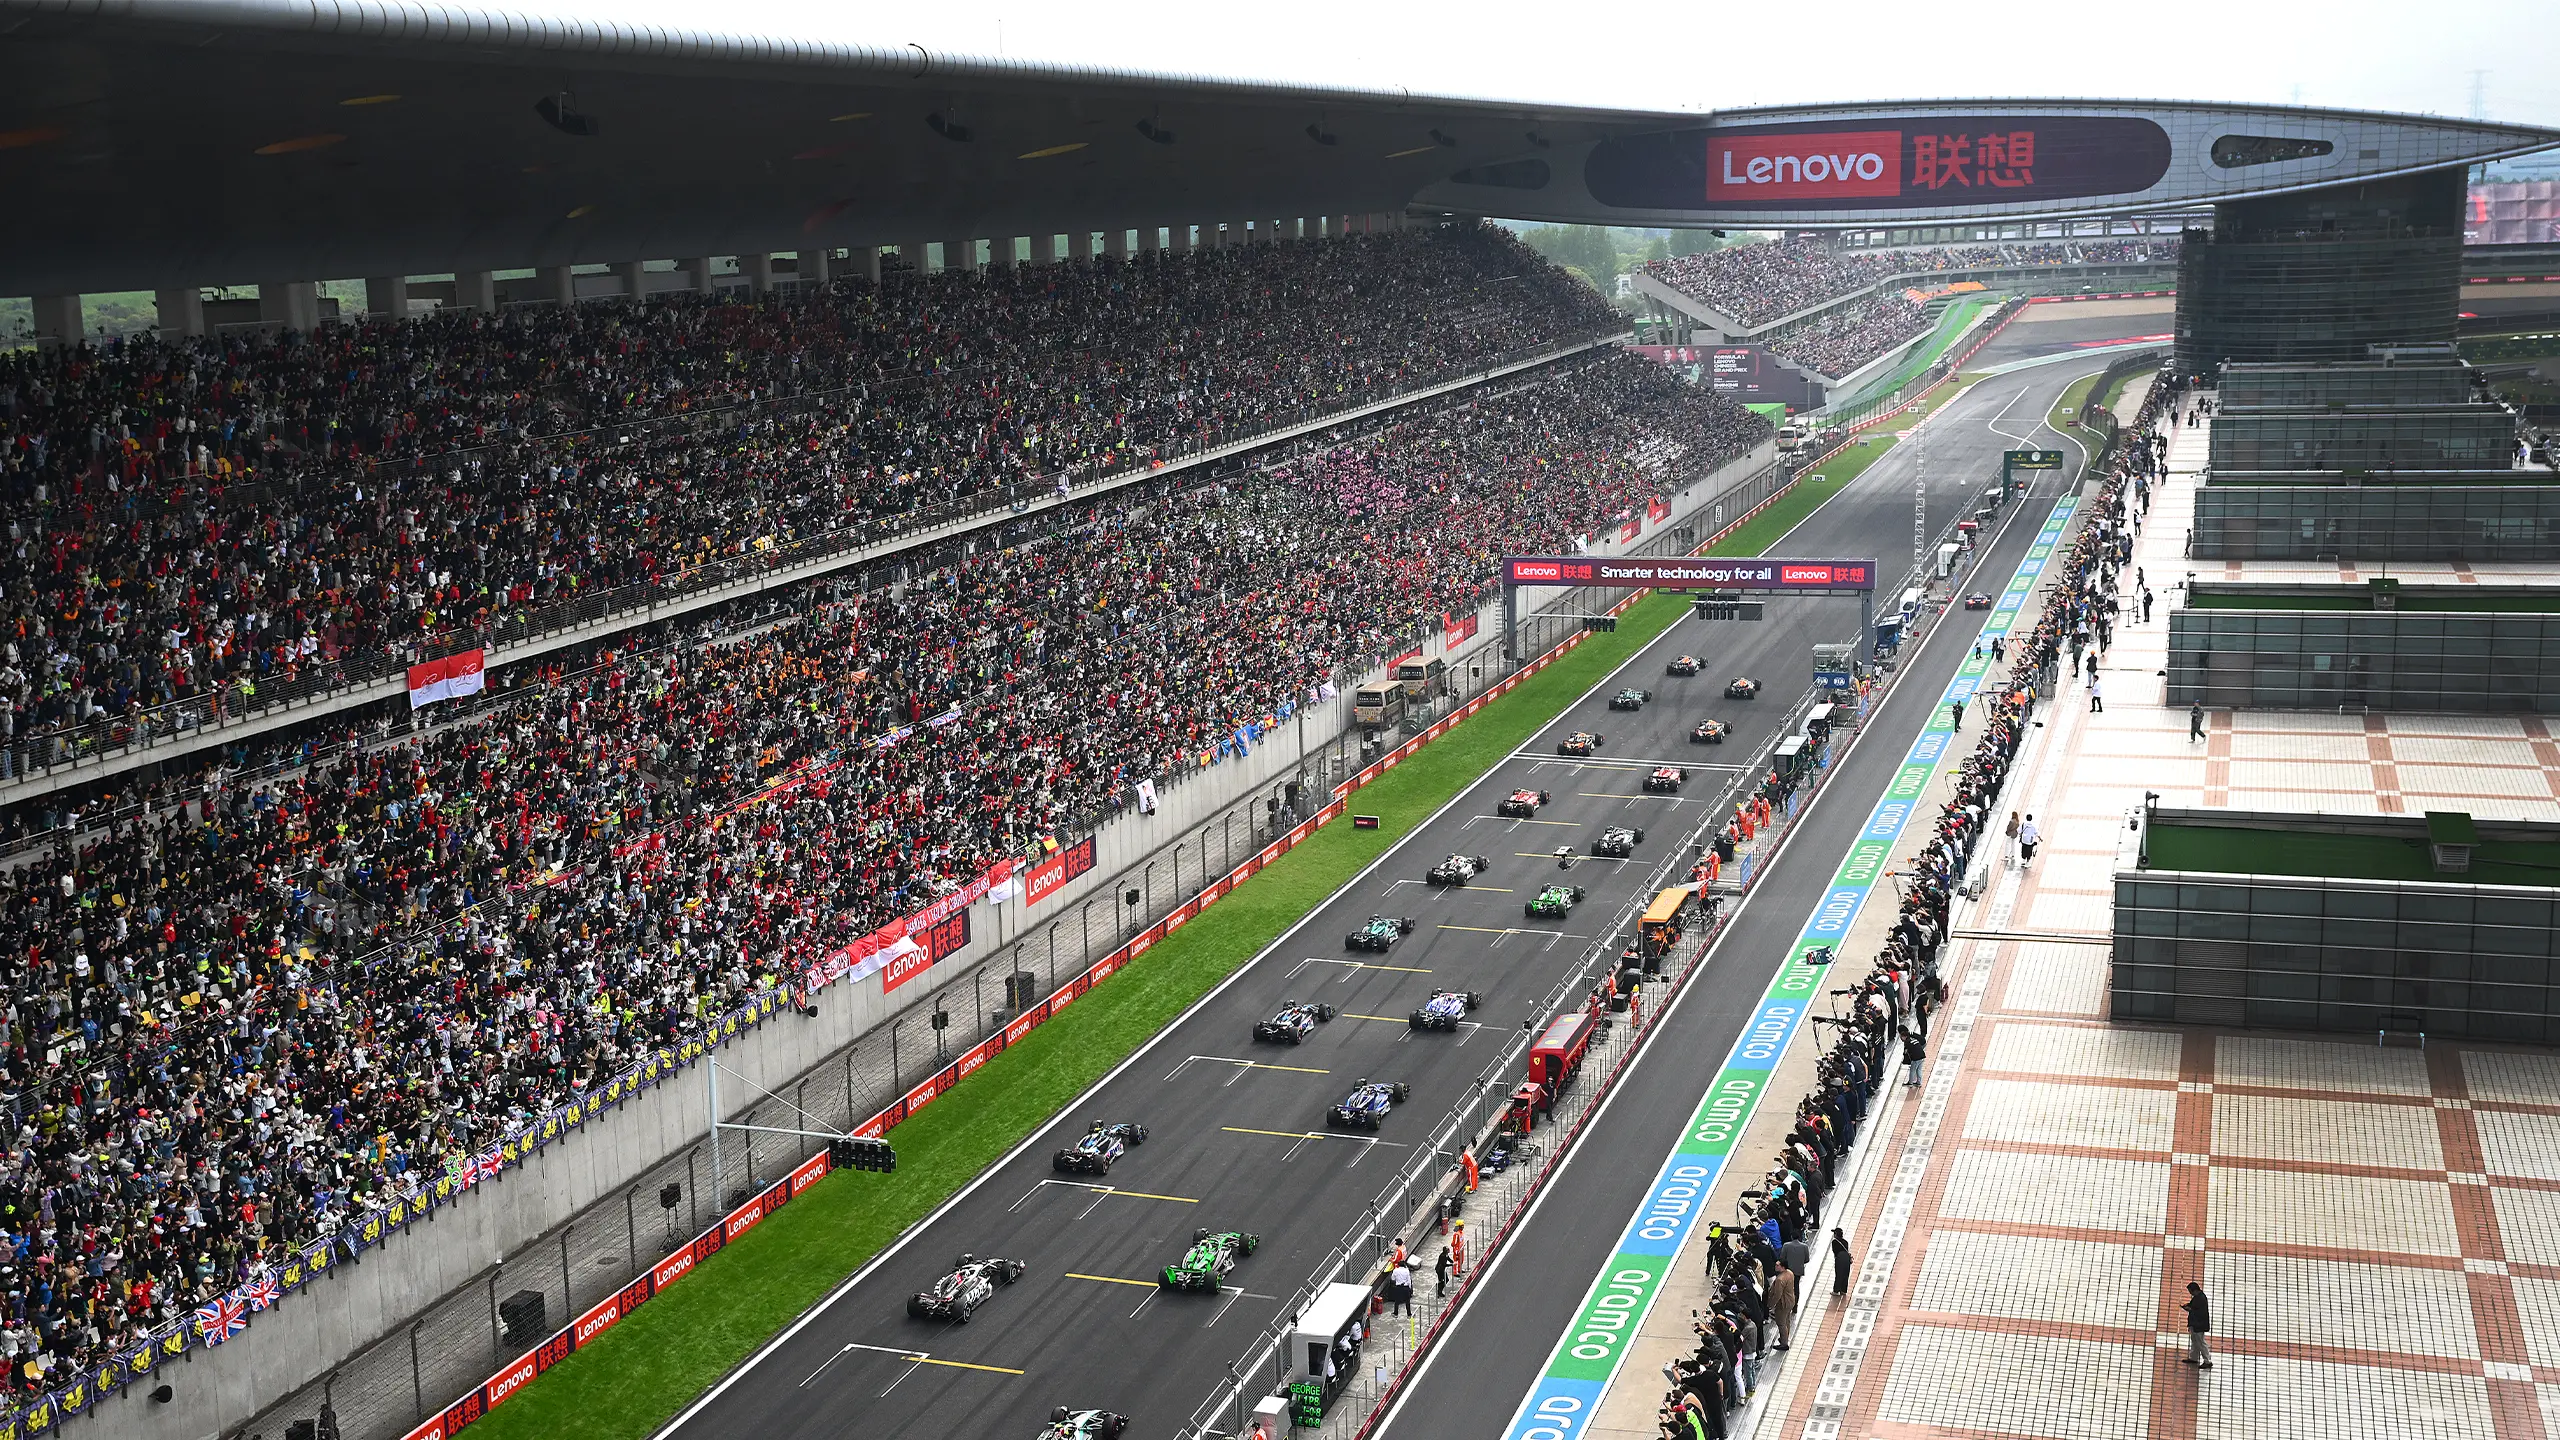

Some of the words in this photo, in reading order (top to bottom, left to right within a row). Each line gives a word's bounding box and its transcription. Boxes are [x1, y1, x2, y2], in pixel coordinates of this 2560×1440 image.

[1723, 150, 1884, 185] Lenovo
[1912, 131, 2034, 190] 联想
[1517, 566, 1557, 576] Lenovo
[1563, 565, 1592, 579] 联想
[1601, 566, 1653, 579] Smarter
[1657, 566, 1732, 582] technology
[1734, 567, 1754, 580] for
[1756, 567, 1772, 580] all
[1785, 569, 1827, 580] Lenovo
[1834, 567, 1865, 582] 联想
[1893, 767, 1927, 795] aramco
[1870, 804, 1908, 835] aramco
[1066, 841, 1091, 879] 联想
[1262, 847, 1277, 864] Lenovo
[1845, 845, 1885, 880] aramco
[1029, 865, 1062, 897] Lenovo
[1233, 868, 1248, 885] Lenovo
[1201, 889, 1217, 908] Lenovo
[1814, 891, 1859, 931] aramco
[934, 914, 963, 957] 联想
[1167, 912, 1184, 931] Lenovo
[1131, 936, 1149, 955] Lenovo
[888, 944, 928, 983] Lenovo
[1092, 963, 1111, 983] Lenovo
[1051, 990, 1071, 1011] Lenovo
[1007, 1019, 1029, 1042] Lenovo
[1741, 1007, 1795, 1059] aramco
[986, 1033, 1002, 1059] 联想
[960, 1051, 983, 1075] Lenovo
[937, 1067, 954, 1095] 联想
[588, 1095, 600, 1112] 44
[909, 1085, 934, 1110] Lenovo
[1694, 1080, 1756, 1142] aramco
[544, 1119, 556, 1138] 44
[567, 1106, 580, 1125] 44
[883, 1103, 902, 1133] 联想
[521, 1131, 533, 1152] 44
[859, 1122, 880, 1146] novo
[794, 1163, 823, 1191] Lenovo
[764, 1183, 786, 1215] 联想
[1638, 1165, 1709, 1240] aramco
[389, 1203, 403, 1225] 44
[728, 1206, 760, 1237] Lenovo
[311, 1248, 327, 1270] 44
[696, 1228, 720, 1262] 联想
[656, 1254, 691, 1288] Lenovo
[621, 1279, 647, 1315] 联想
[577, 1306, 616, 1342] Lenovo
[1570, 1269, 1652, 1360] aramco
[538, 1333, 568, 1372] 联想
[490, 1364, 532, 1402] Lenovo
[1290, 1383, 1320, 1395] GEORGE
[28, 1404, 49, 1431] 44
[447, 1393, 480, 1436] 联想
[1520, 1396, 1583, 1440] ara
